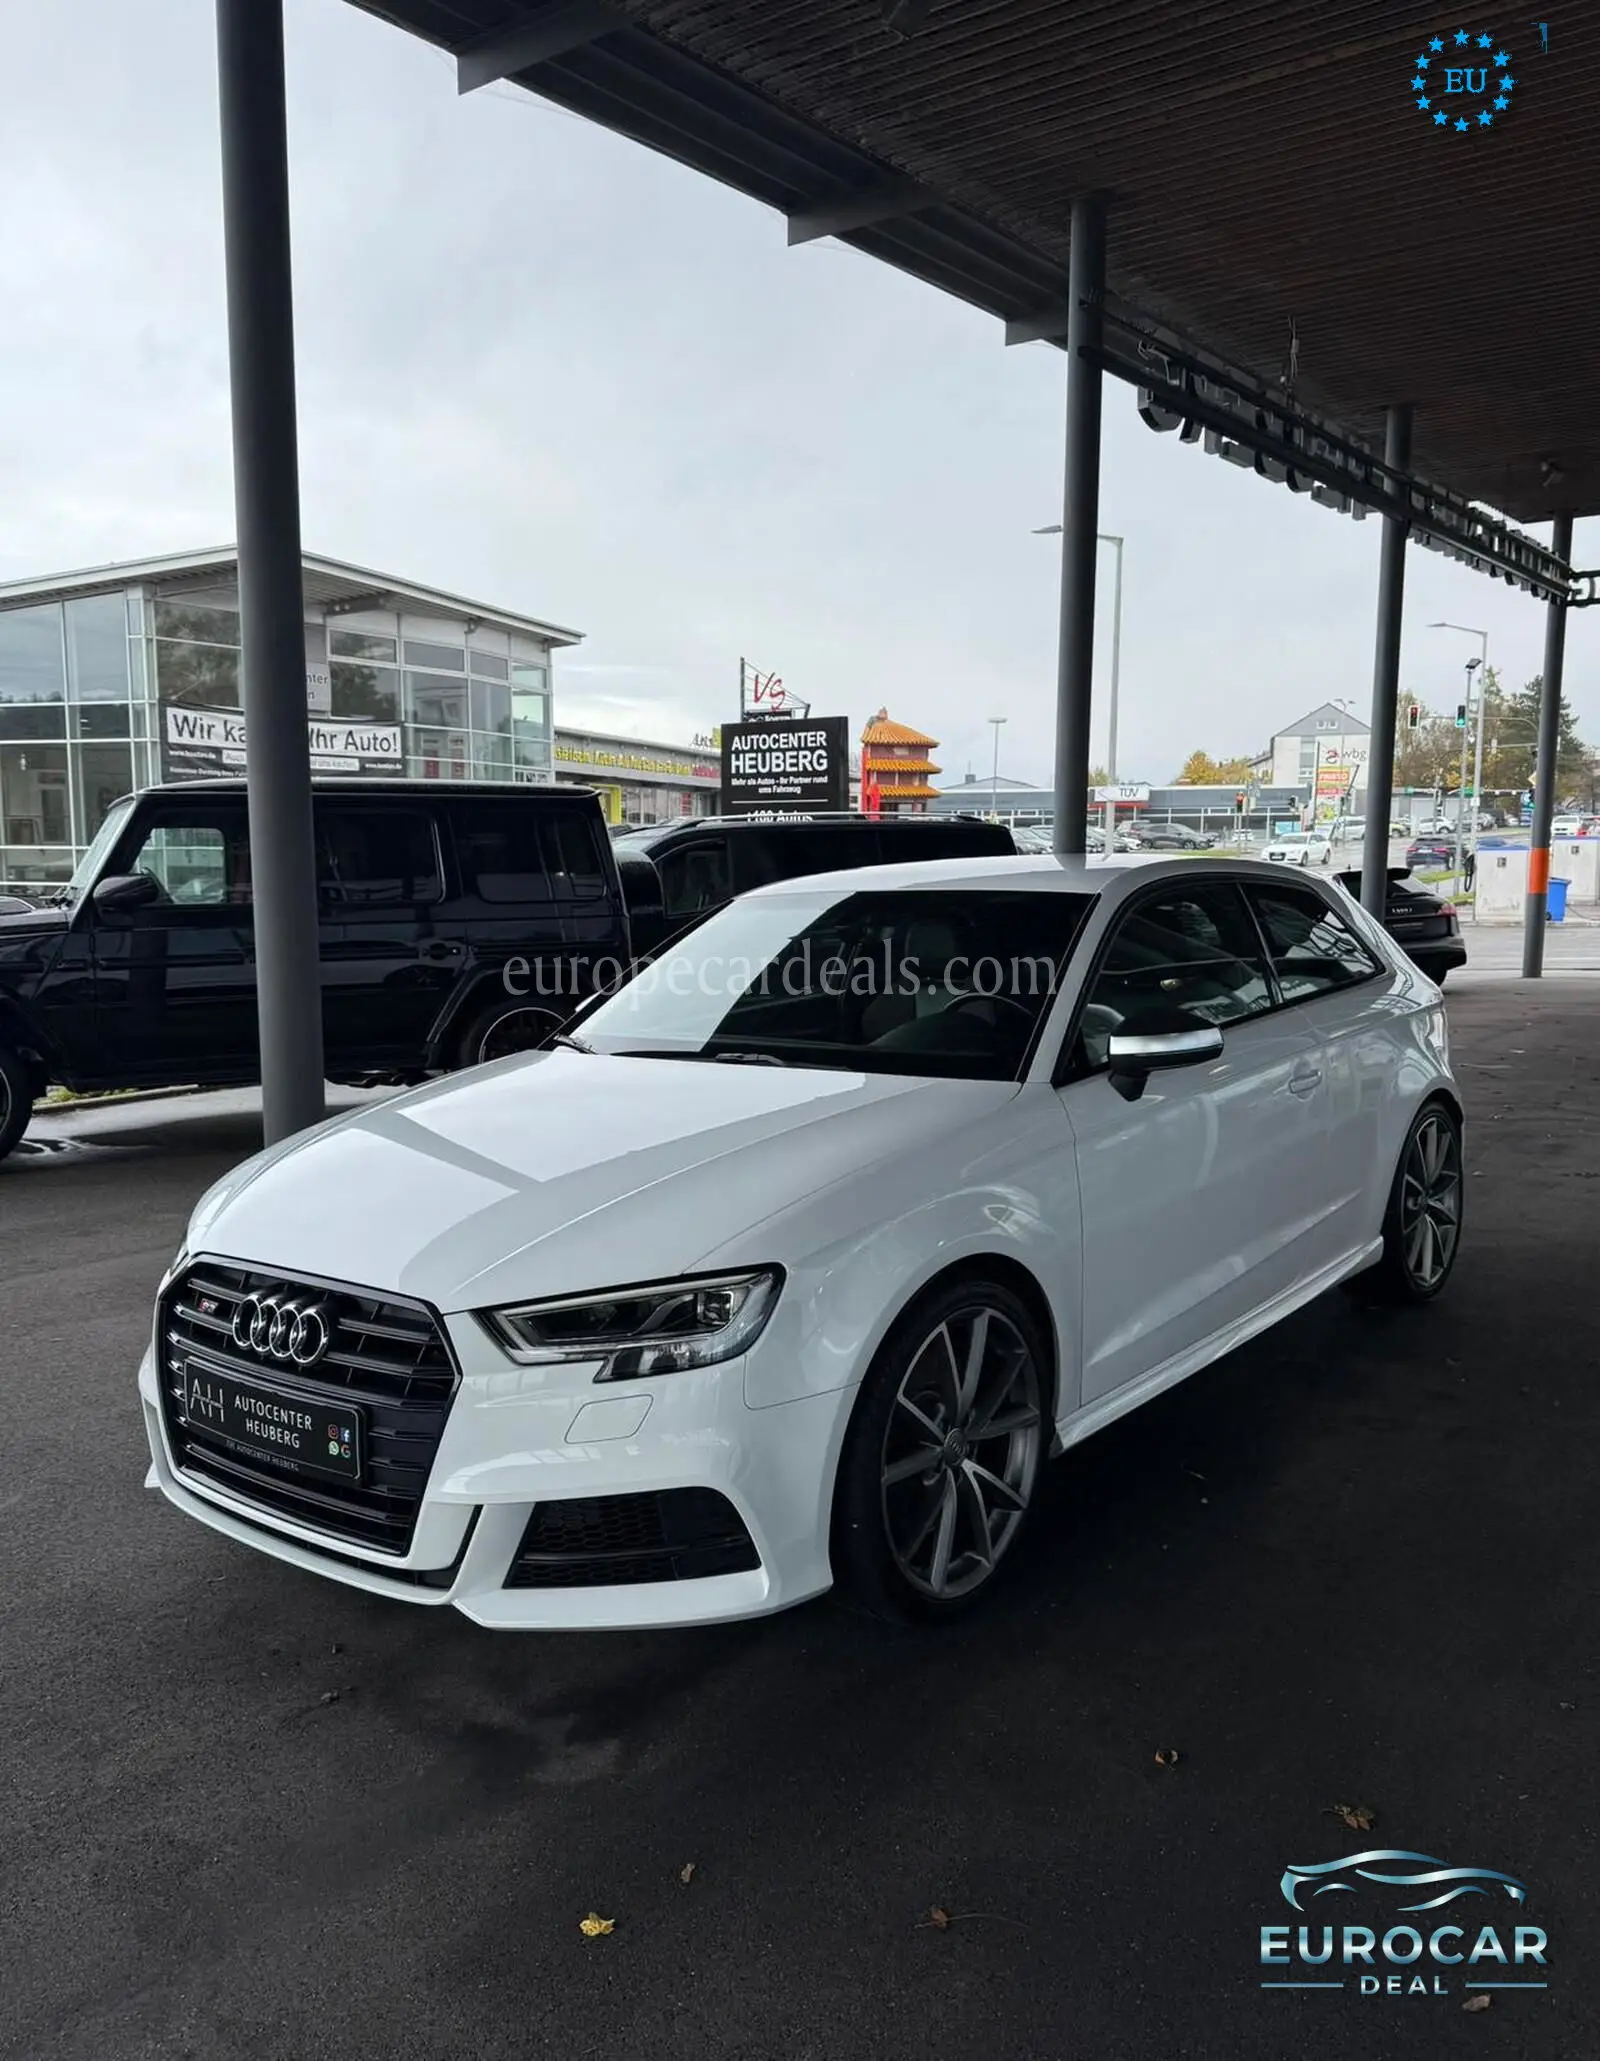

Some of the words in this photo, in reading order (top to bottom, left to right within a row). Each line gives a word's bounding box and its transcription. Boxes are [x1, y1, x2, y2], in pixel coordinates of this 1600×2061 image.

[173, 714, 216, 740] Wir
[310, 728, 337, 750] Ihr
[344, 730, 397, 753] Auto!
[731, 731, 828, 751] AUTOCENTER
[731, 749, 829, 775] HEUBERG
[757, 776, 775, 786] Autos
[812, 774, 829, 784] rund
[772, 784, 802, 796] Fahrzeug
[234, 1394, 313, 1432] AUTOCENTER
[245, 1418, 301, 1449] HEUBERG
